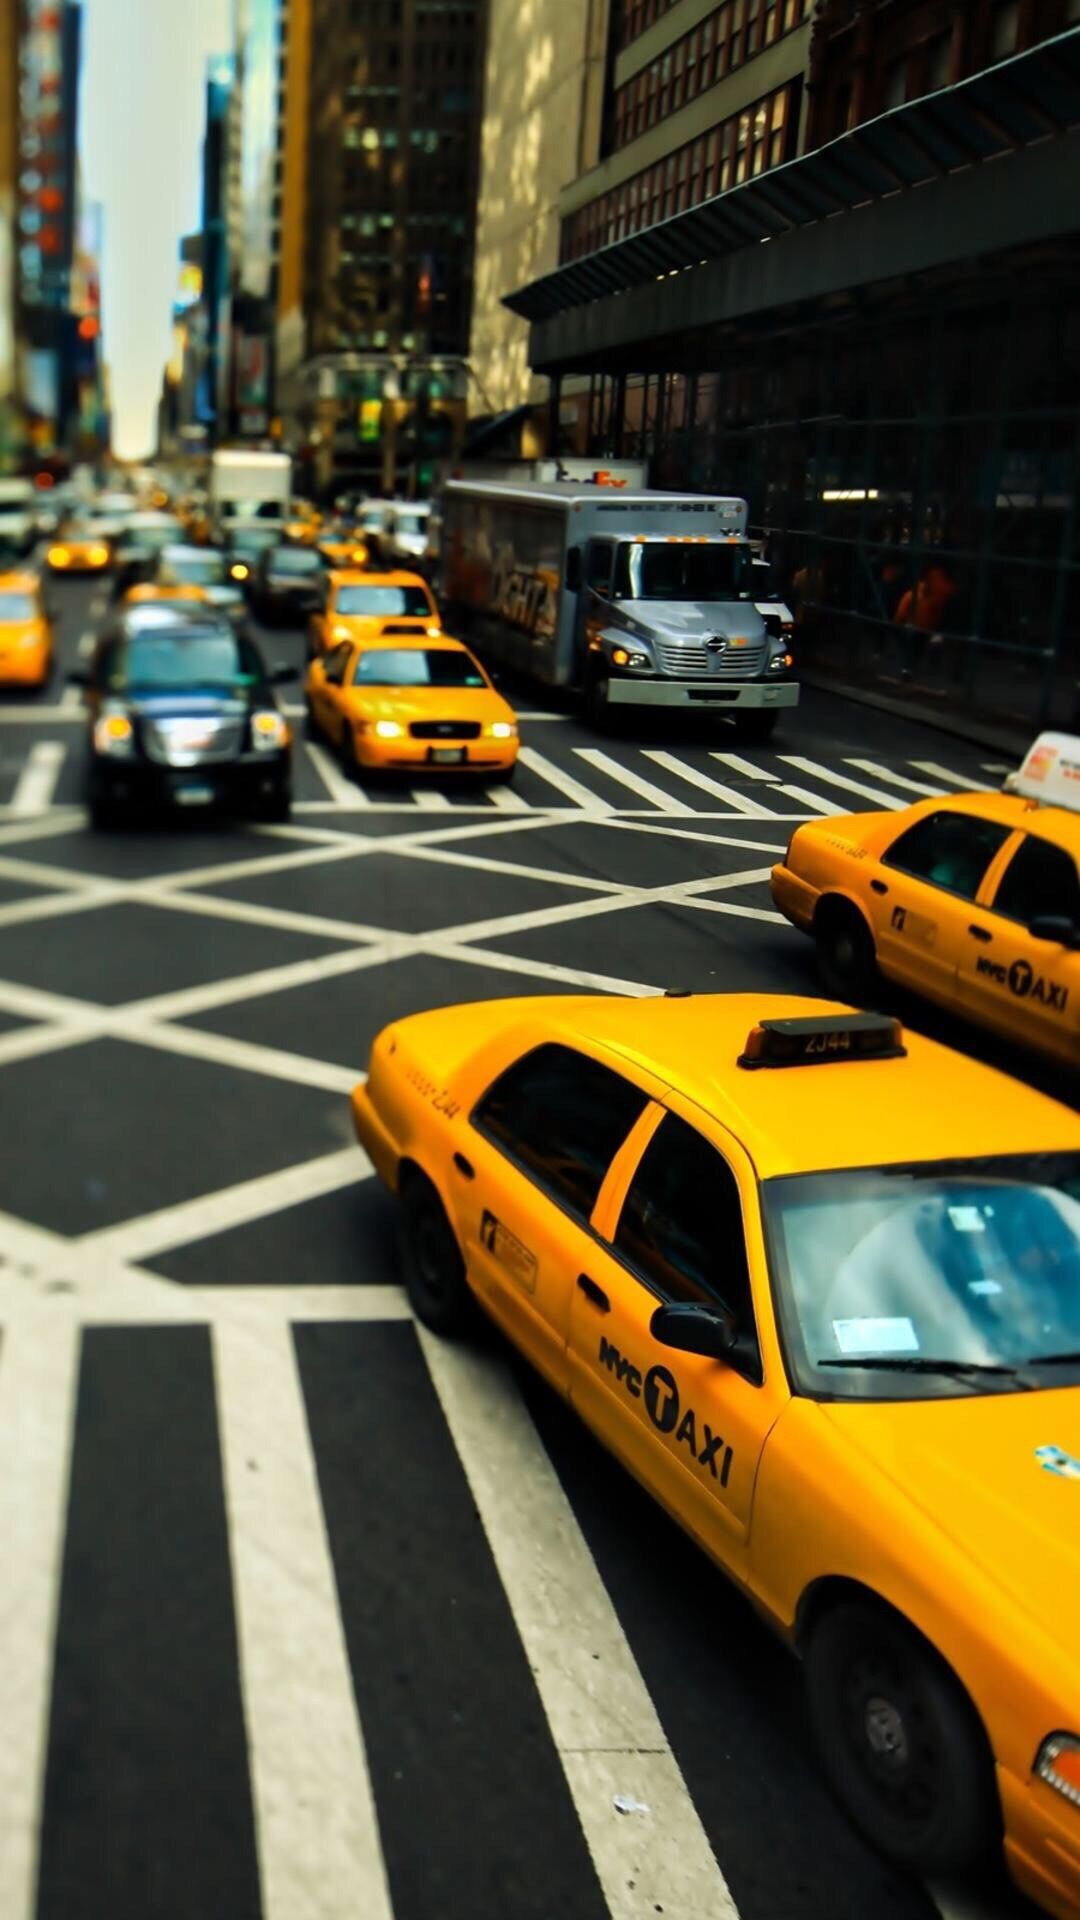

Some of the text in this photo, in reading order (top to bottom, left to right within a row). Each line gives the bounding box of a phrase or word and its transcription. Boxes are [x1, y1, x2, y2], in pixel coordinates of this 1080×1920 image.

[976, 956, 1069, 1014] NYC TAXI
[805, 1032, 851, 1054] 2J44
[599, 1336, 734, 1488] NYC TAXI
